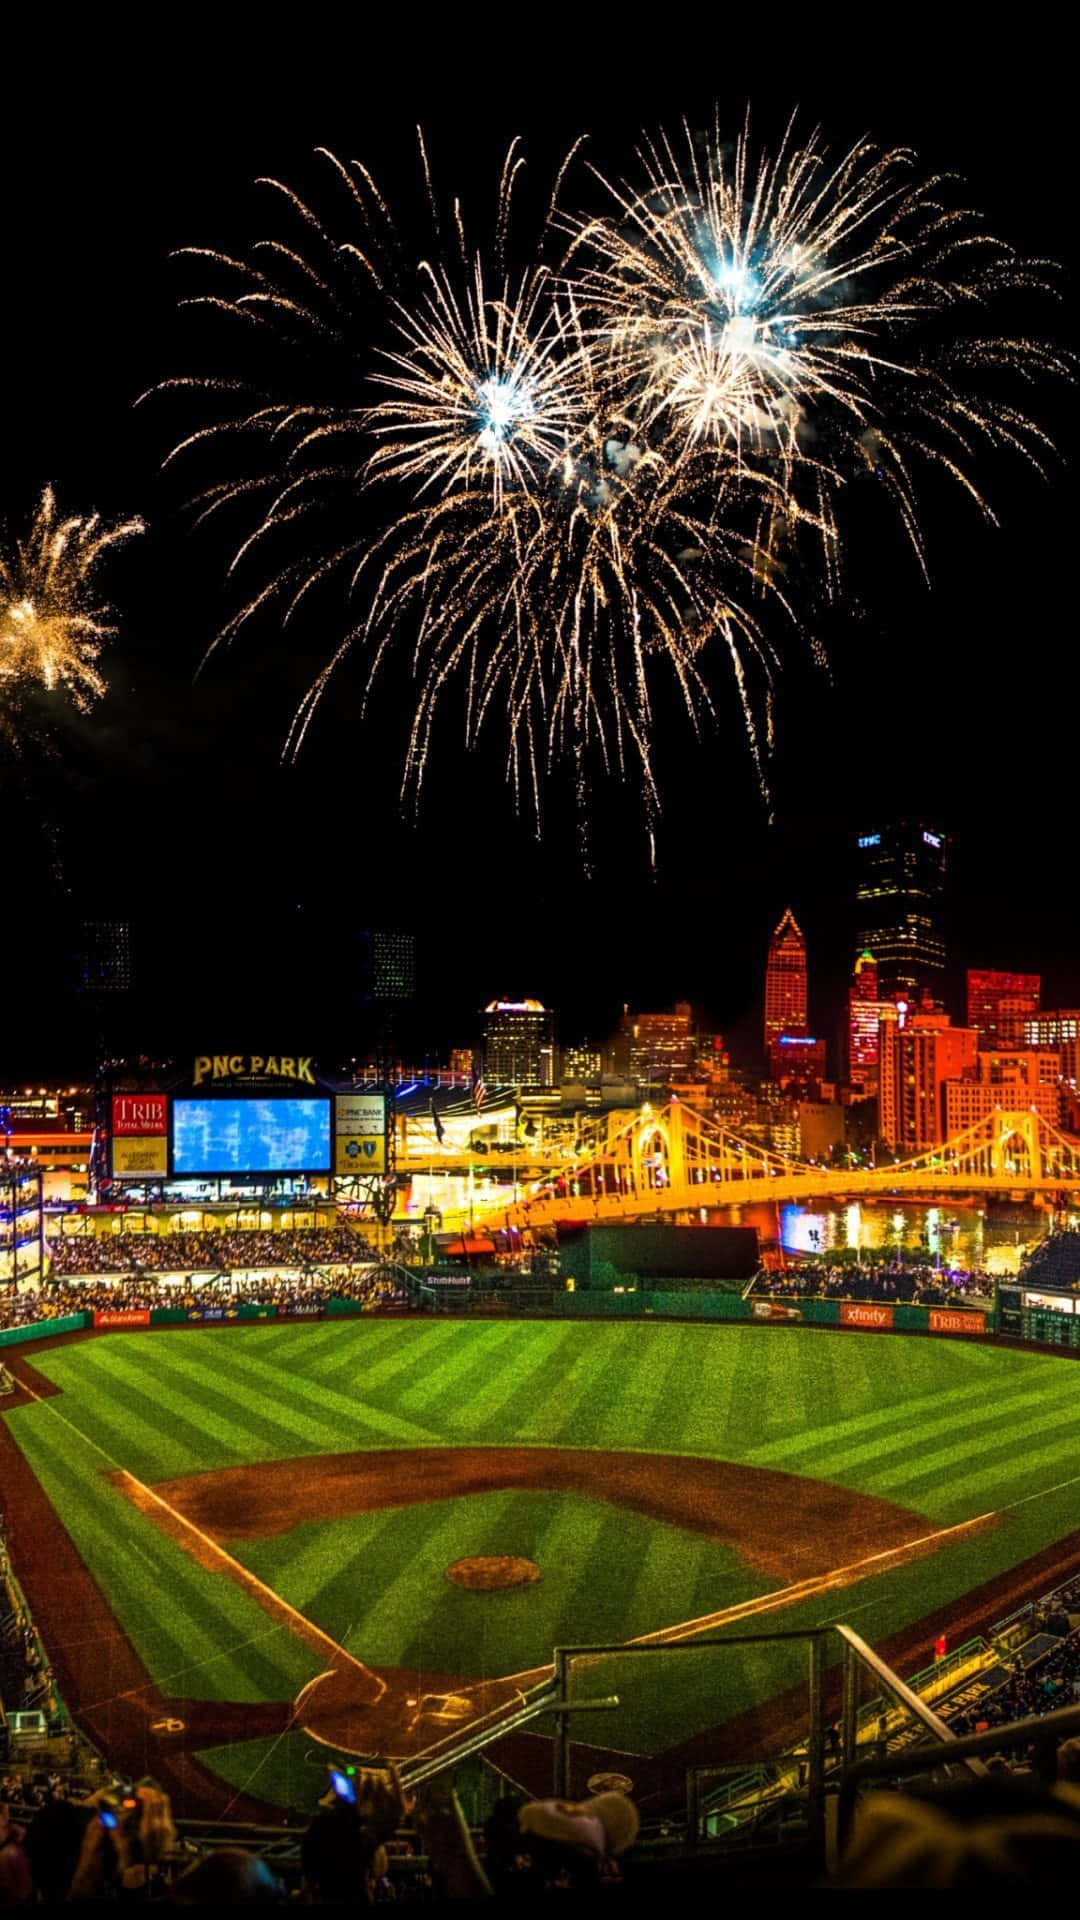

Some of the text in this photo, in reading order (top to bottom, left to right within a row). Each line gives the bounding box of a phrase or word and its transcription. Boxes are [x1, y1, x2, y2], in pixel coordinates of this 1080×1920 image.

[192, 1055, 316, 1086] PNC PARK
[115, 1099, 163, 1120] TRIB
[847, 1304, 887, 1324] xfinity
[931, 1312, 961, 1329] TRIB
